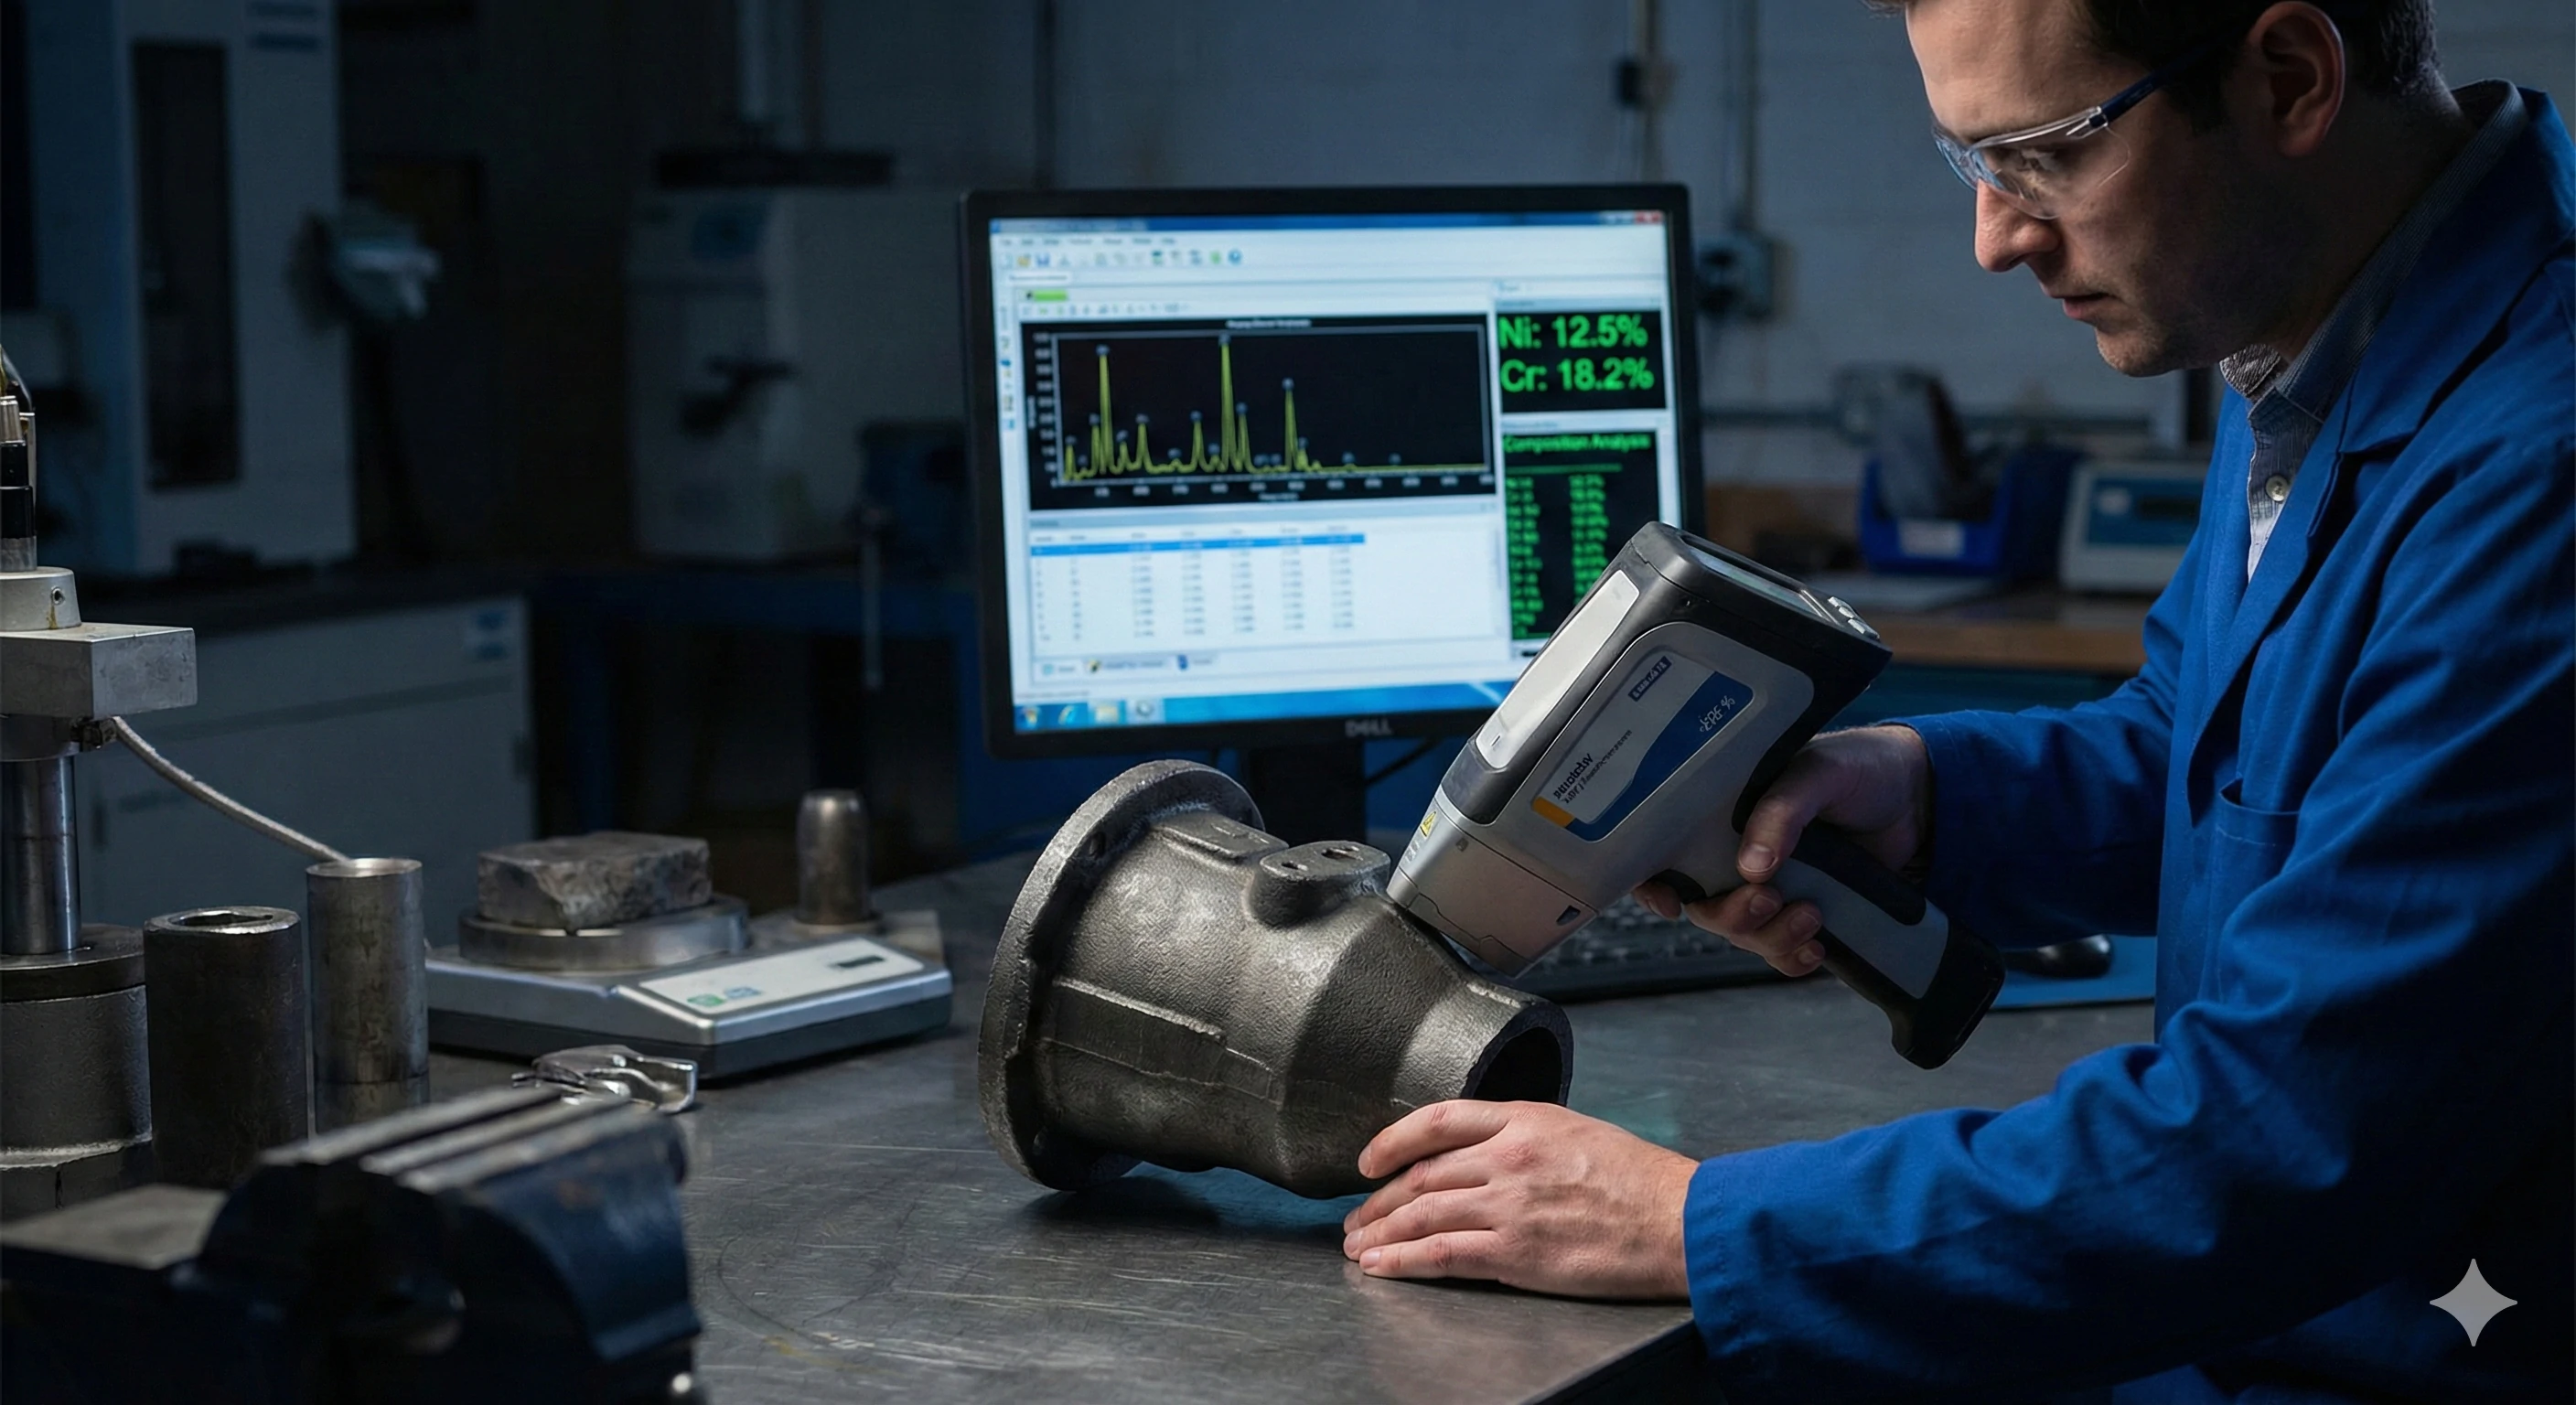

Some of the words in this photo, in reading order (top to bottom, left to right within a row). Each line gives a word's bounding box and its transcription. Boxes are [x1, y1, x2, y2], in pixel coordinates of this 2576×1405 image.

[1498, 316, 1541, 349] Ni:
[1551, 314, 1648, 349] 12.5%
[1500, 359, 1548, 392] Cr:
[1557, 357, 1655, 391] 18.2%
